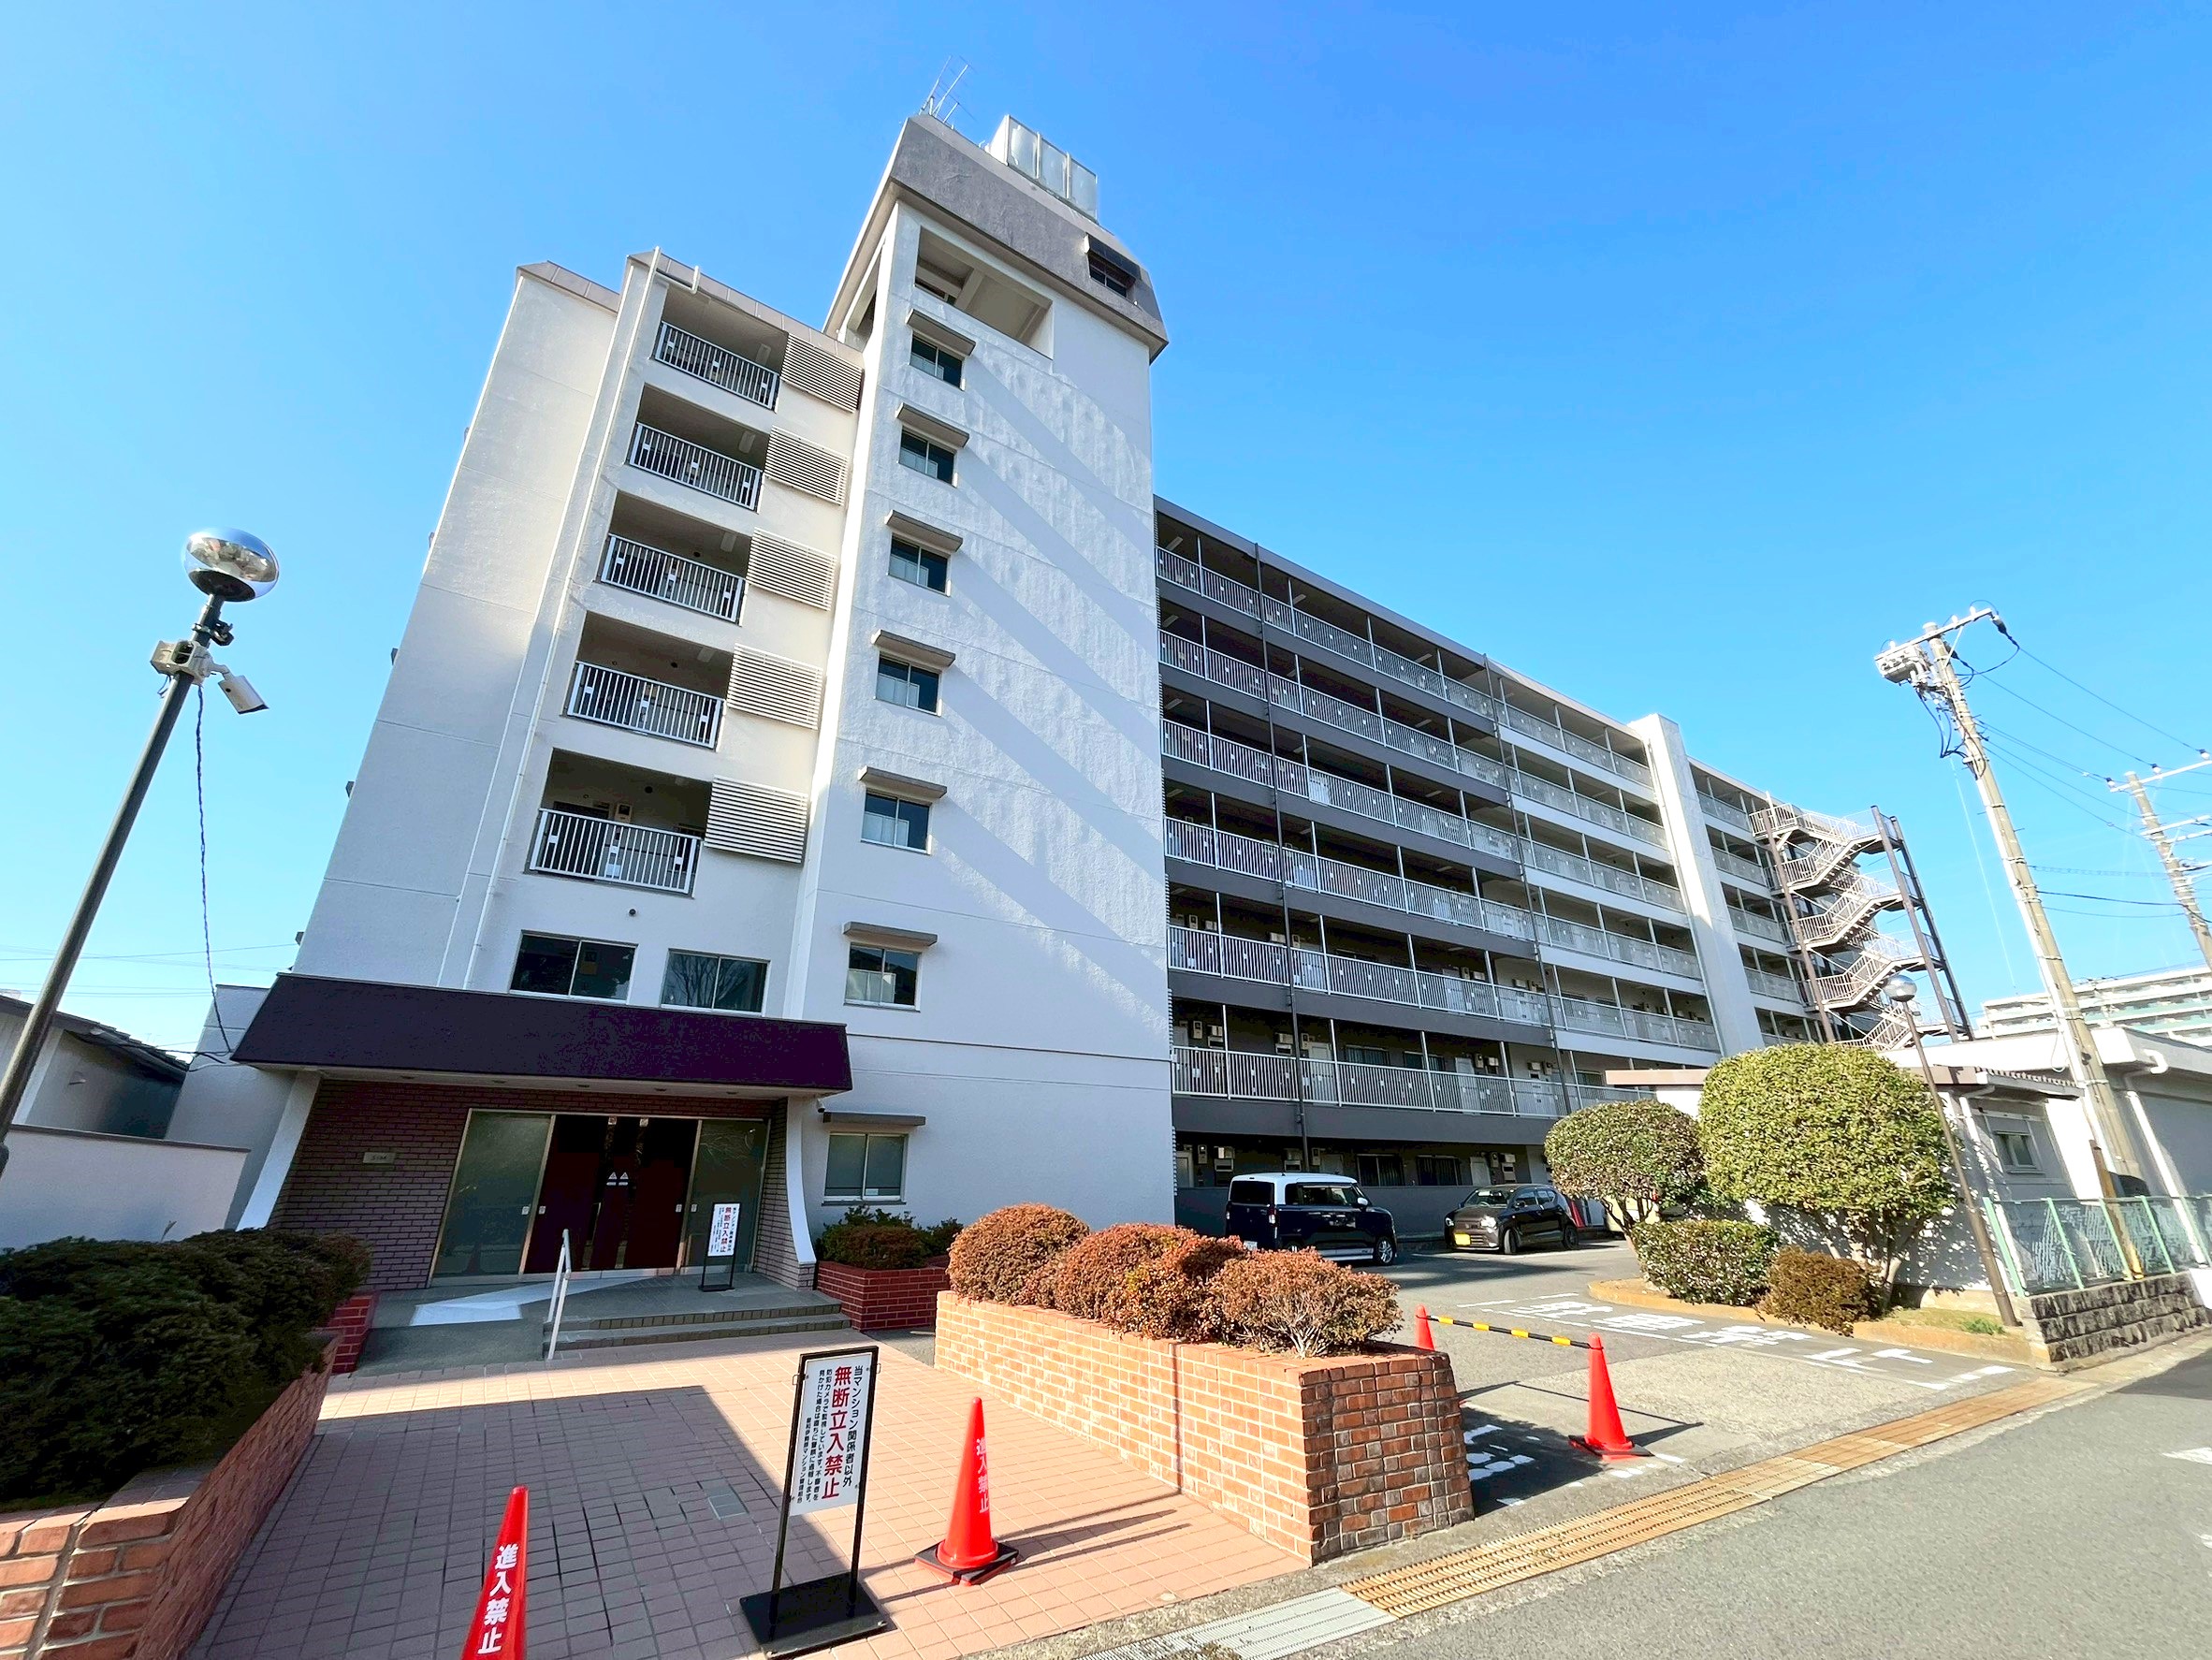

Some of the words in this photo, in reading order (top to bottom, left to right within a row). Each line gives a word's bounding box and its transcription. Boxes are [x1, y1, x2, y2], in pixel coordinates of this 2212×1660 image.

[822, 1366, 851, 1499] 無断立入禁止
[843, 1365, 864, 1488] 当マンション関係者以外
[478, 1543, 518, 1654] 進入禁止
